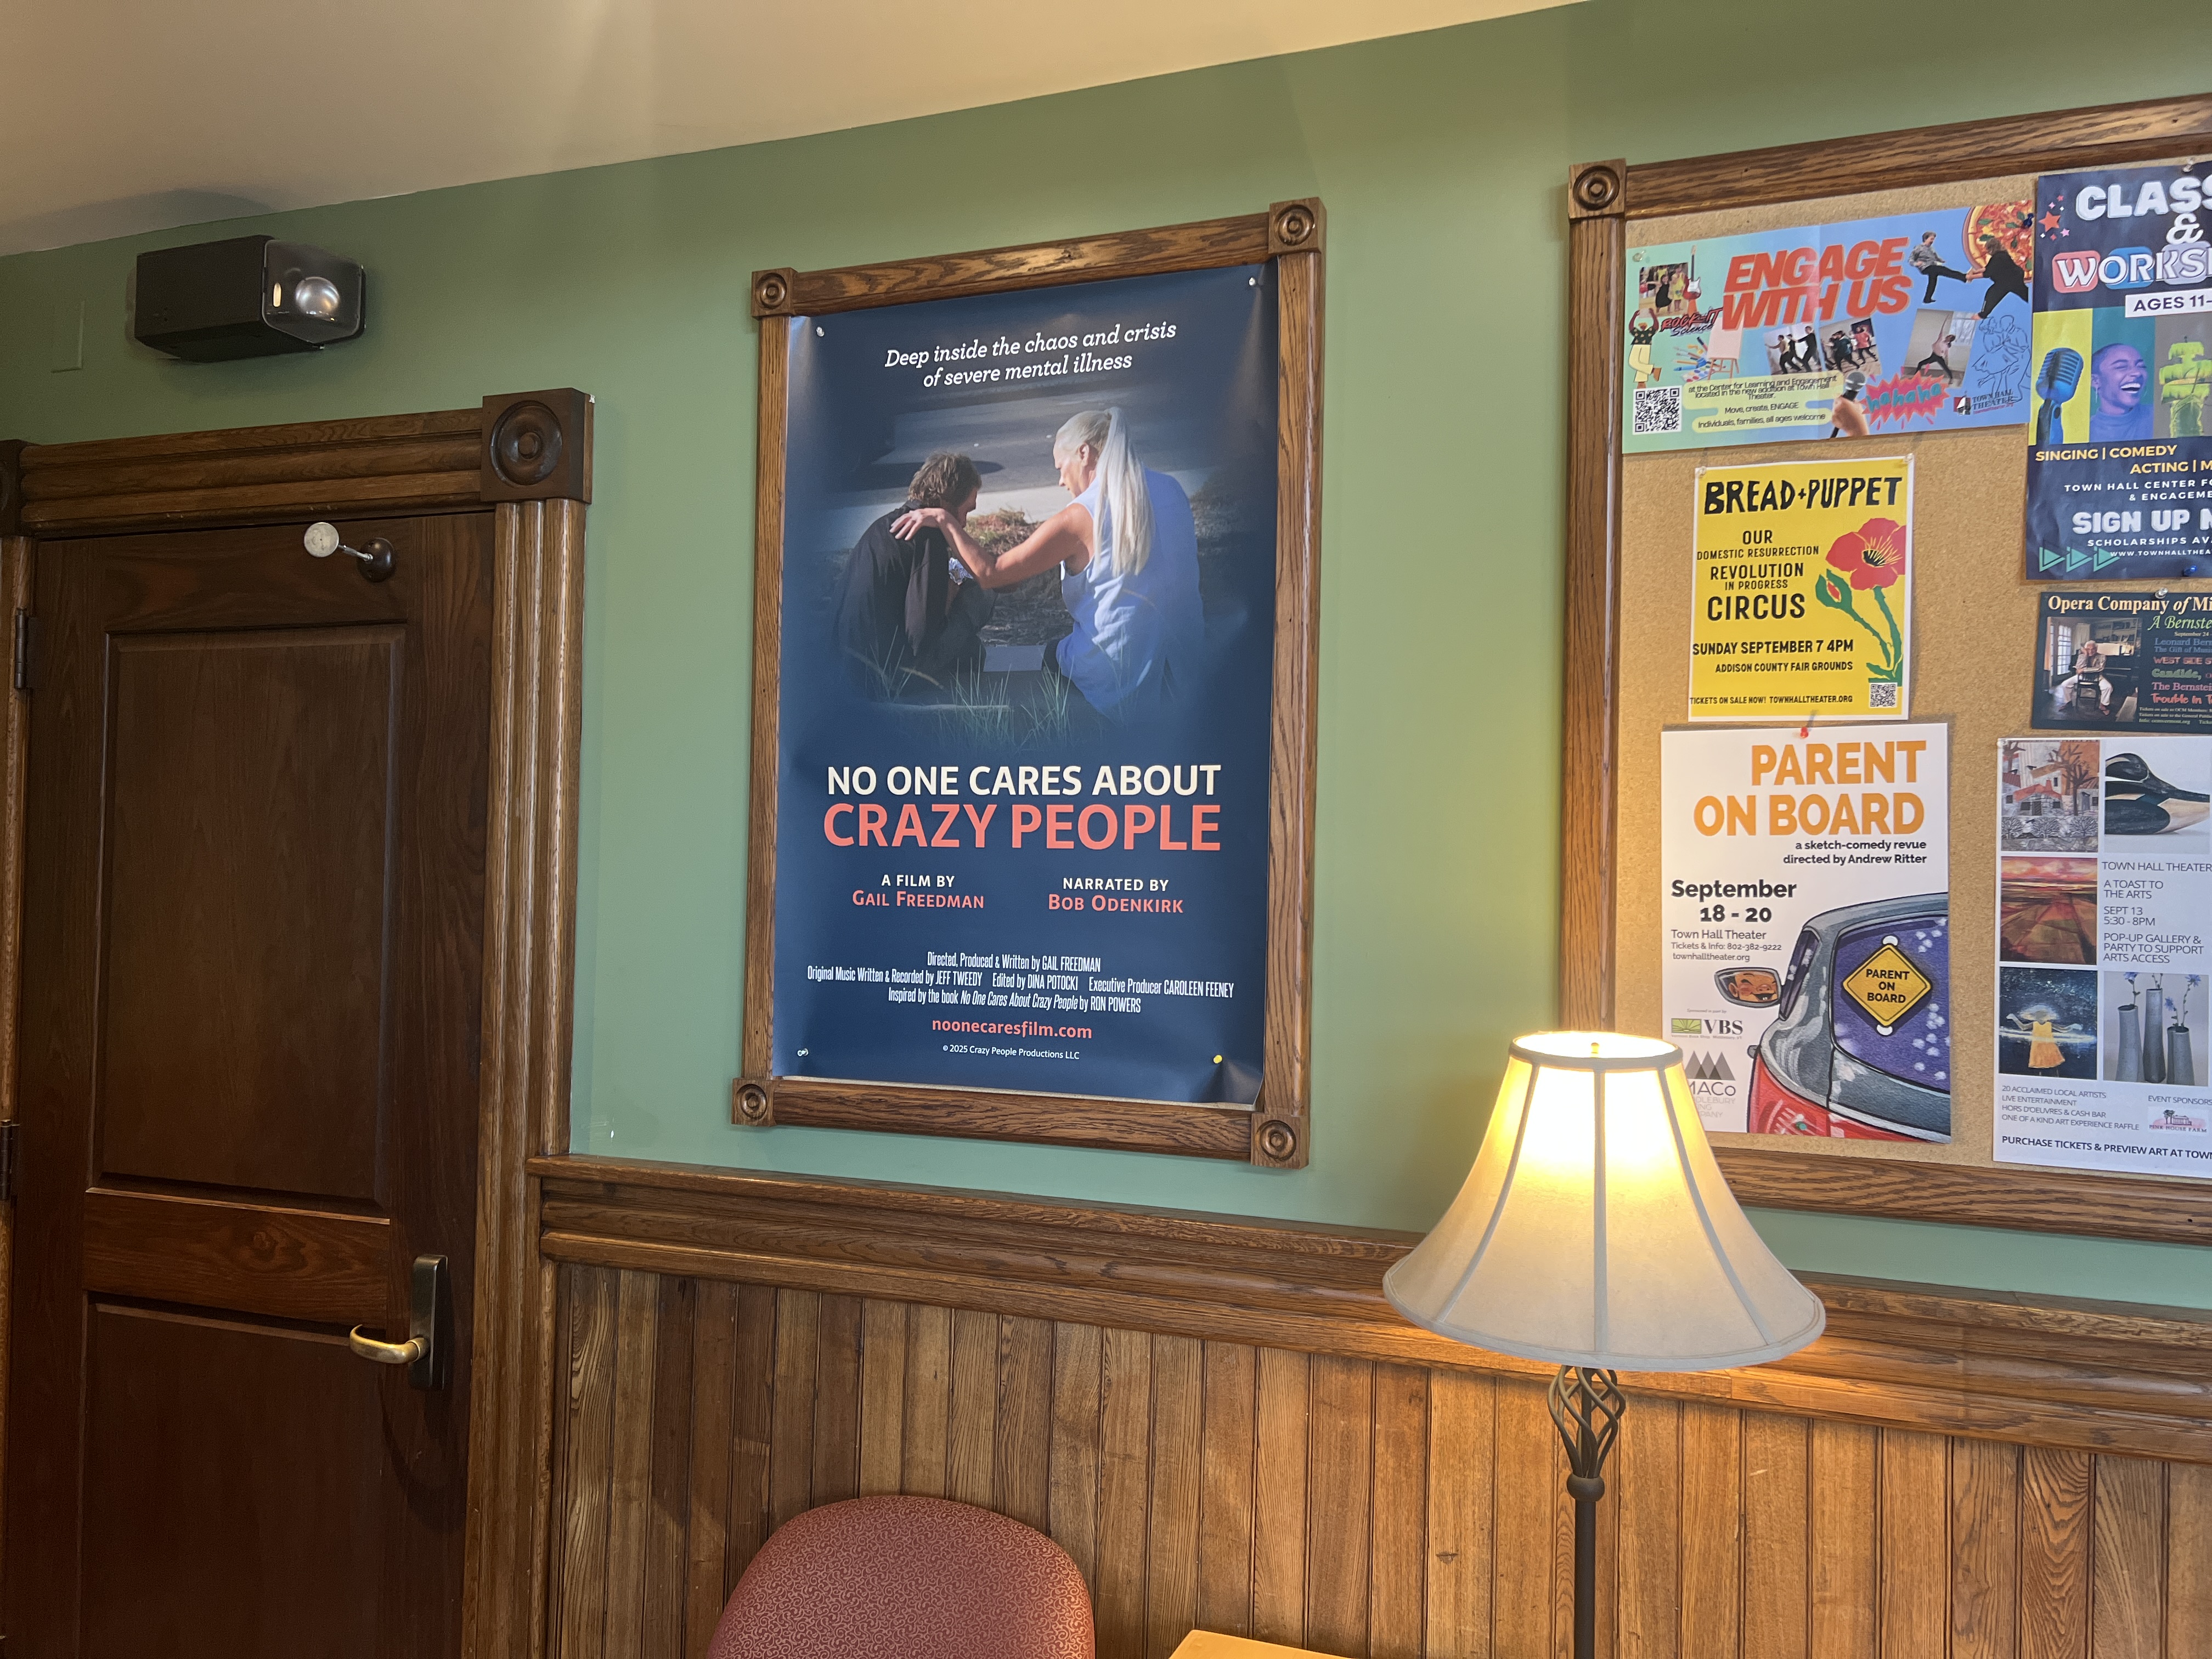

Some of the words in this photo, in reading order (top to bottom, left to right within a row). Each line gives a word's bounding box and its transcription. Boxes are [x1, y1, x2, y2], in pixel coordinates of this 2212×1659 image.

[1724, 237, 1910, 293] ENGAGE
[1846, 275, 1912, 318] US
[1722, 283, 1842, 331] WITH
[2134, 296, 2184, 312] AGES
[884, 349, 929, 368] Deep
[934, 339, 987, 362] inside
[992, 336, 1020, 356] the
[1024, 332, 1077, 353] chaos
[1082, 324, 1120, 347] and
[1124, 321, 1176, 342] crisis
[923, 367, 943, 387] of
[944, 368, 1000, 385] severe
[1005, 354, 1069, 380] mental
[1073, 352, 1132, 373] illness
[2035, 449, 2098, 461] SINGING
[2109, 445, 2177, 458] COMEDY
[2130, 462, 2188, 474] ACTING
[2107, 482, 2139, 490] HALL
[2145, 480, 2195, 489] CENTER
[2072, 511, 2141, 534] SIGN
[2151, 509, 2190, 532] UP
[1743, 530, 1773, 544] OUR
[2087, 537, 2187, 546] SCHOLARSHIPS
[1697, 549, 1744, 560] DOMESTIC
[1748, 546, 1819, 557] RESURRECTION
[1711, 563, 1803, 580] REVOLUTION
[1725, 582, 1734, 590] IN
[1739, 579, 1788, 589] PROGRESS
[1708, 593, 1805, 621] CIRCUS
[2048, 596, 2094, 614] Opera
[2098, 596, 2169, 614] Company
[2173, 596, 2191, 614] of
[1692, 642, 1738, 655] SUNDAY
[1741, 641, 1813, 653] SEPTEMBER
[1816, 640, 1824, 652] 7
[1827, 639, 1853, 652] 4PM
[1715, 664, 1752, 673] ADDISON
[1756, 663, 1788, 672] COUNTY
[1791, 662, 1809, 671] FAIR
[1812, 662, 1853, 670] GROUNDS
[1752, 741, 1926, 786] PARENT
[828, 766, 877, 795] NO
[887, 766, 959, 795] ONE
[969, 765, 1081, 795] CARES
[1092, 765, 1221, 795] ABOUT
[1694, 795, 1756, 836] ON
[1769, 792, 1924, 835] BOARD
[824, 803, 997, 848] CRAZY
[1012, 804, 1220, 850] PEOPLE
[1804, 840, 1891, 851] sketch-comedy
[1784, 855, 1830, 864] directed
[1833, 855, 1846, 866] by
[1848, 854, 1892, 863] Andrew
[1894, 854, 1927, 863] Ritter
[2102, 862, 2135, 870] TOWN
[2138, 862, 2164, 871] HALL
[2166, 863, 2212, 872] THEATER
[881, 874, 891, 886] A
[896, 875, 930, 887] FILM
[936, 876, 955, 887] BY
[1063, 878, 1143, 891] NARRATED
[1149, 879, 1169, 891] BY
[2113, 880, 2146, 888] TOAST
[2148, 881, 2163, 889] TO
[1671, 879, 1797, 902] September
[2104, 890, 2124, 898] THE
[2126, 890, 2152, 899] ARTS
[1701, 905, 1725, 922] 18
[1745, 907, 1772, 922] 20
[2104, 906, 2128, 915] SEPT
[2132, 907, 2143, 915] 13
[2132, 917, 2155, 926] 8PM
[1671, 929, 1699, 939] Town
[1702, 929, 1723, 939] Hall
[1725, 930, 1767, 939] Theater
[2104, 933, 2143, 942] POP-UP
[2146, 934, 2191, 944] GALLERY
[1727, 943, 1782, 951] 802-382-9222
[2104, 943, 2136, 952] PARTY
[2138, 944, 2152, 952] TO
[2155, 945, 2204, 954] SUPPORT
[927, 951, 958, 967] Directed,
[960, 953, 993, 968] Produced
[1002, 954, 1029, 969] Written
[1031, 956, 1040, 972] by
[1042, 956, 1058, 970] GAIL
[1060, 956, 1101, 972] FREEDMAN
[1673, 953, 1750, 962] townhalltheater.org
[2103, 953, 2129, 962] ARTS
[2131, 954, 2170, 963] ACCESS
[1866, 969, 1910, 980] PARENT
[808, 966, 833, 982] Original
[835, 967, 855, 981] Music
[857, 967, 883, 982] Written
[891, 968, 923, 984] Recorded
[926, 970, 934, 986] by
[935, 970, 950, 985] JEFF
[953, 971, 982, 986] TWEEDY
[992, 973, 1014, 988] Edited
[1017, 974, 1025, 990] by
[1028, 974, 1045, 989] DINA
[1047, 975, 1078, 991] POTOCKI
[1089, 977, 1125, 992] Executive
[1127, 978, 1162, 994] Producer
[1164, 980, 1203, 996] CAROLEEN
[1206, 981, 1234, 998] FEENEY
[1878, 981, 1895, 991] ON
[889, 987, 916, 1003] Inspired
[918, 989, 926, 1005] by
[928, 989, 939, 1003] the
[941, 990, 958, 1005] book
[961, 990, 970, 1005] No
[972, 991, 986, 1005] One
[988, 991, 1007, 1006] Cares
[1009, 992, 1030, 1007] About
[1032, 994, 1052, 1011] Crazy
[1053, 995, 1077, 1011] People
[1079, 996, 1088, 1012] by
[1091, 996, 1105, 1011] RON
[1108, 997, 1141, 1013] POWERS
[1867, 992, 1906, 1003] BOARD
[933, 1020, 1092, 1039] noonecaresfilm.com
[1704, 1019, 1743, 1035] VBS
[950, 1045, 968, 1053] 2025
[969, 1046, 990, 1056] Crazy
[992, 1047, 1017, 1058] People
[1019, 1048, 1063, 1059] Productions
[1065, 1051, 1080, 1059] LLC
[2002, 1136, 2052, 1147] PURCHASE
[2055, 1140, 2092, 1150] TICKETS
[2104, 1144, 2147, 1155] PREVIEW
[2148, 1147, 2168, 1156] ART
[2170, 1149, 2183, 1157] AT
